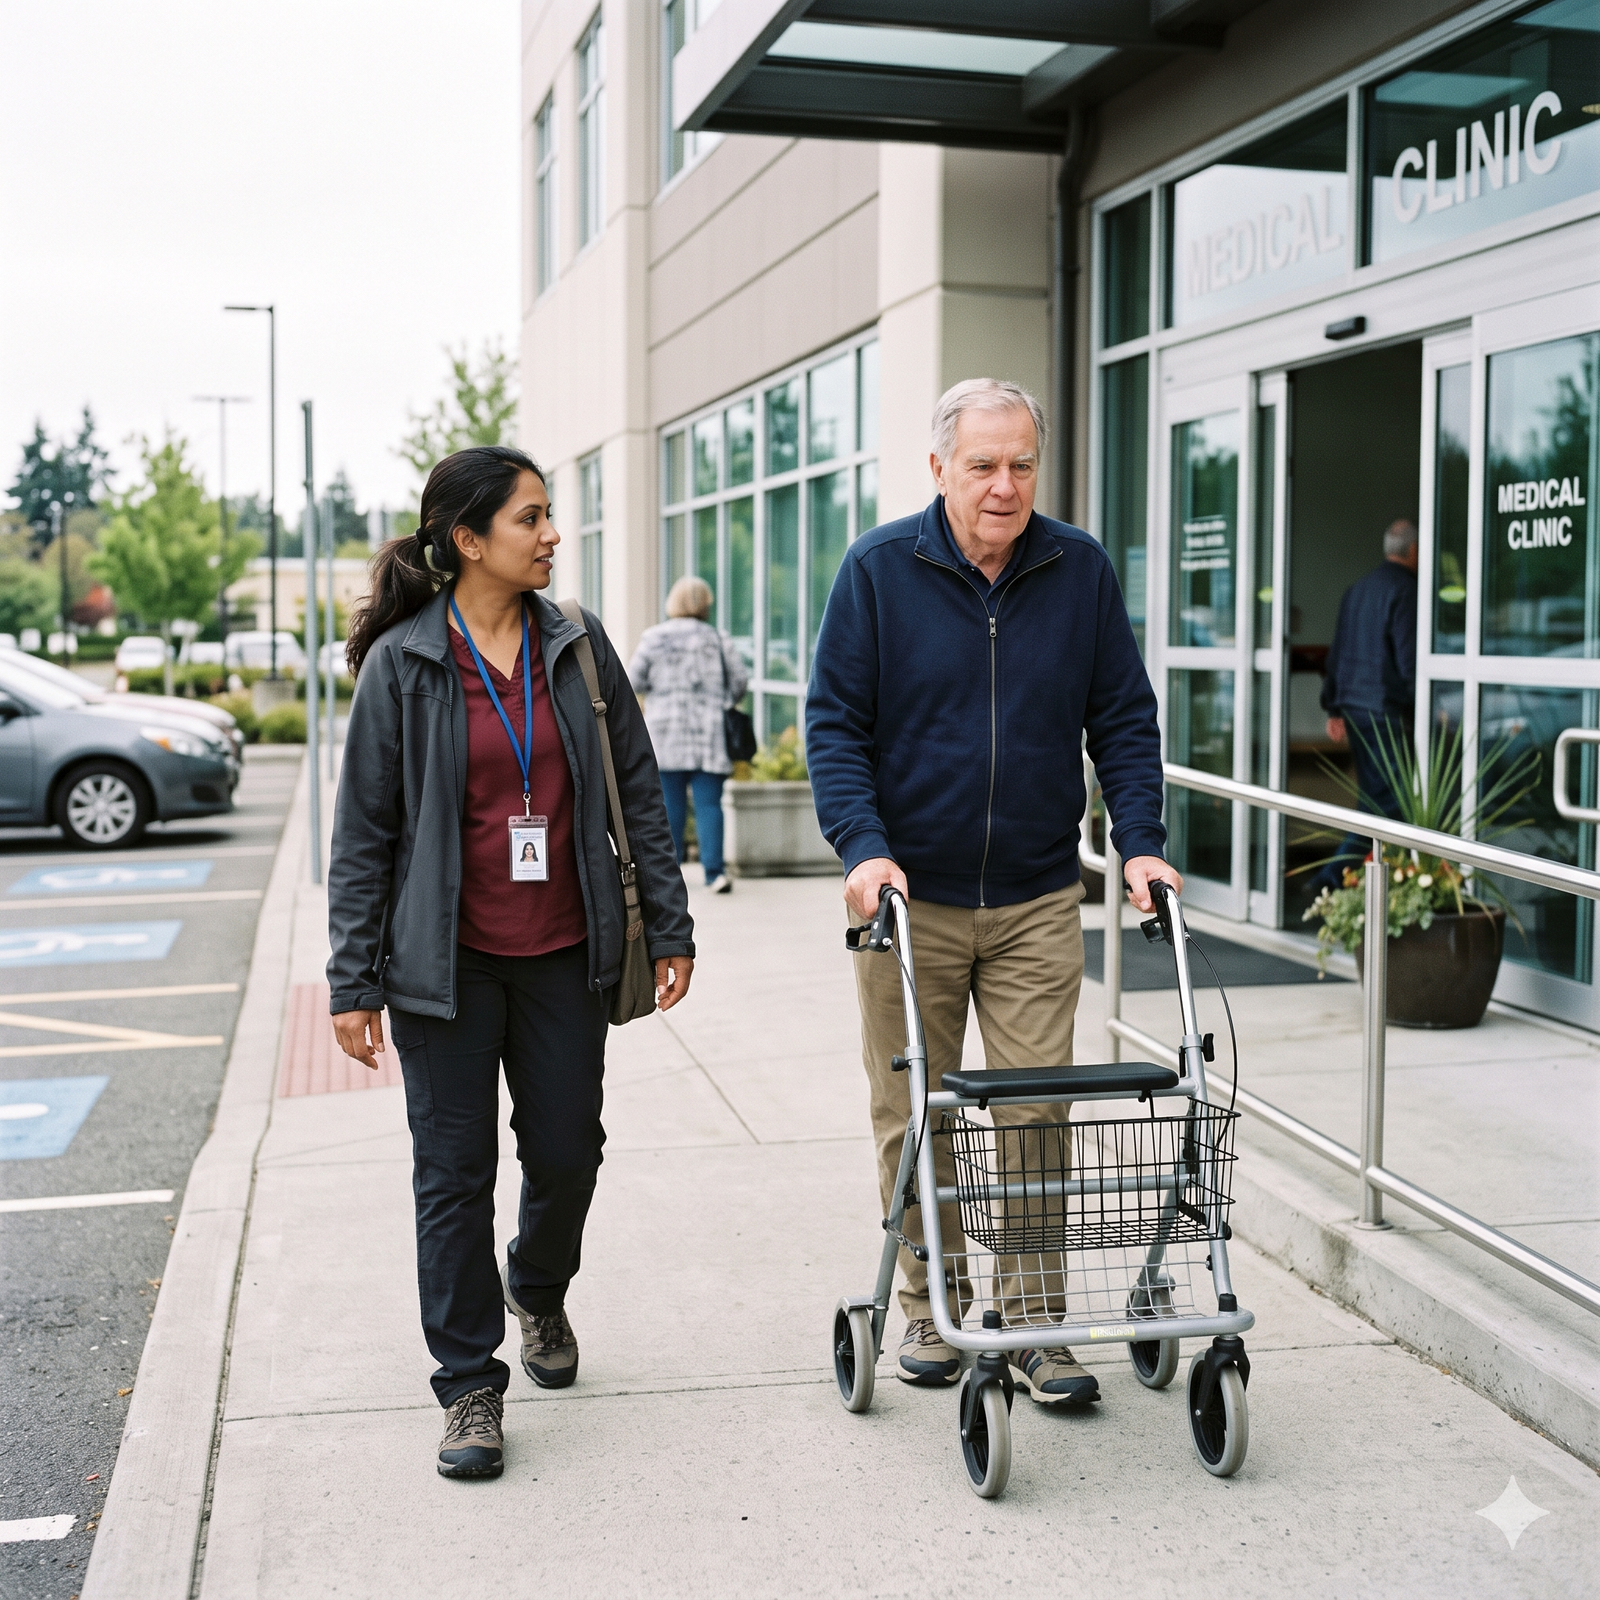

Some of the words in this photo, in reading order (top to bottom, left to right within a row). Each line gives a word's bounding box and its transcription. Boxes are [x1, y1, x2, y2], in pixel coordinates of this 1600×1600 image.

[1189, 184, 1343, 298] MEDICAL
[1392, 90, 1563, 224] CLINIC
[1497, 475, 1586, 514] MEDICAL
[1507, 515, 1573, 551] CLINIC
